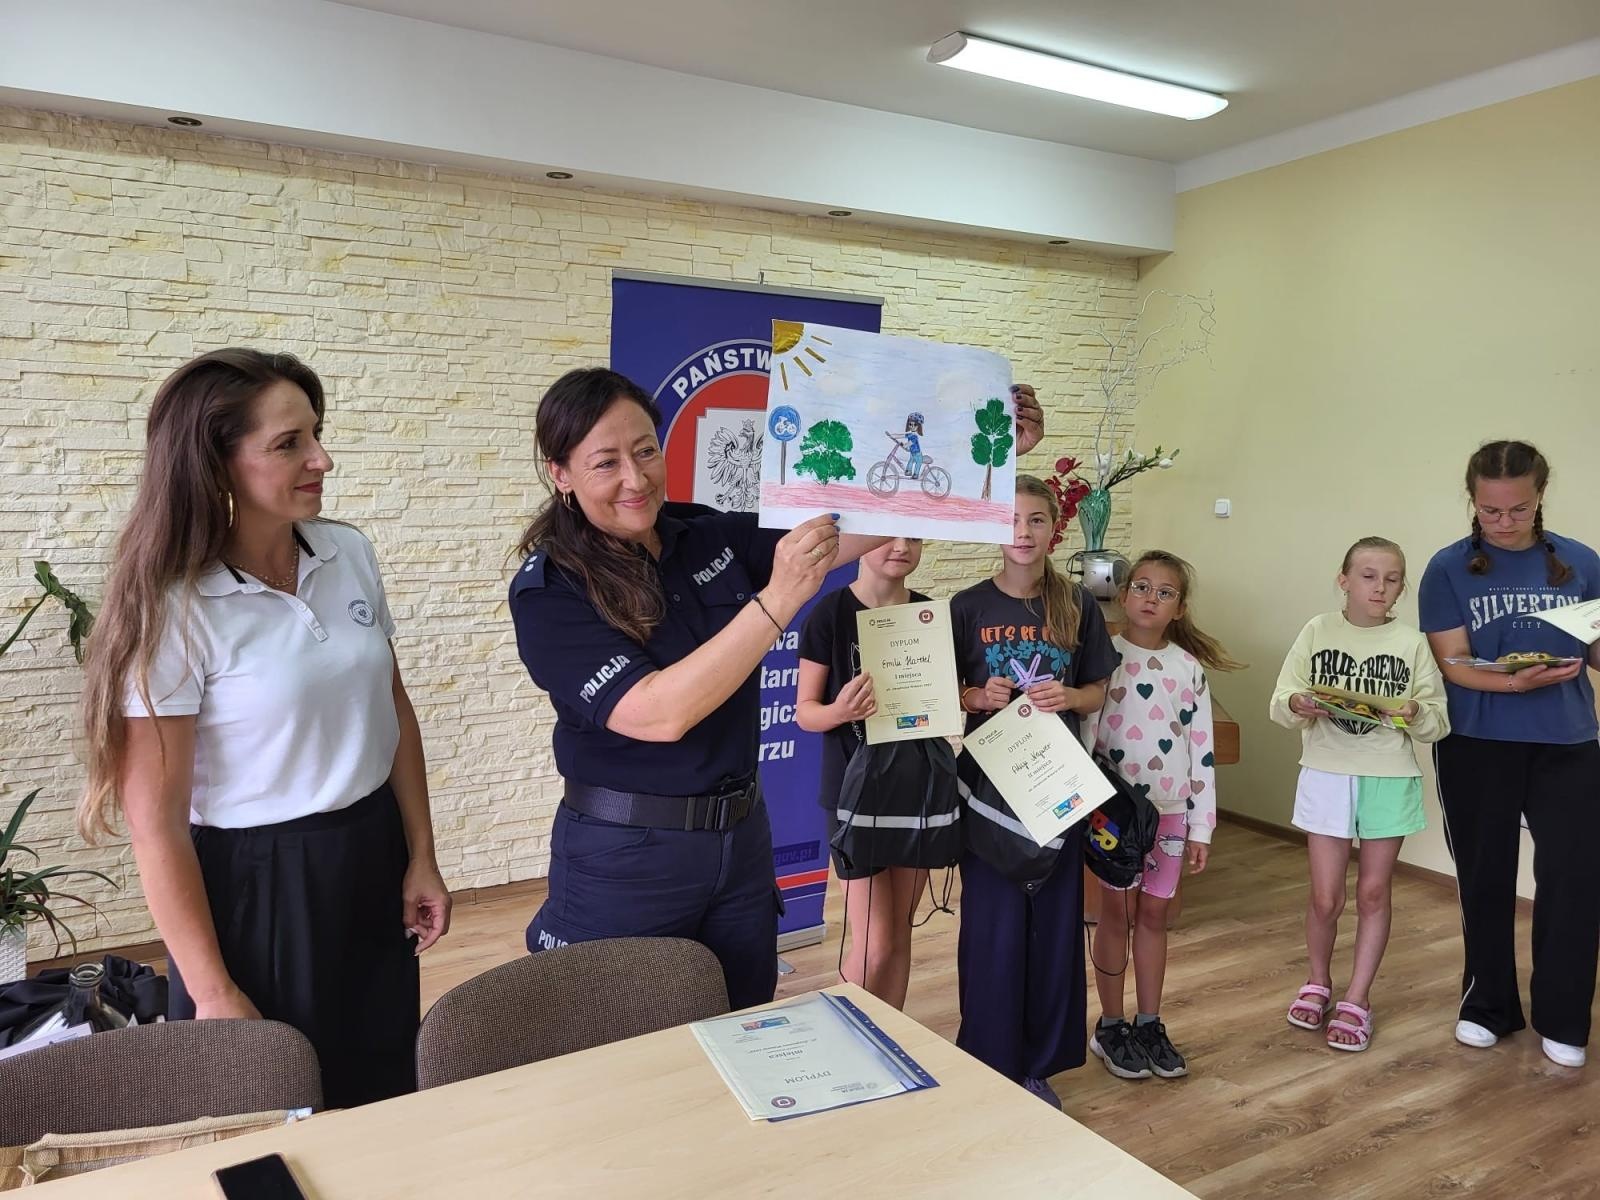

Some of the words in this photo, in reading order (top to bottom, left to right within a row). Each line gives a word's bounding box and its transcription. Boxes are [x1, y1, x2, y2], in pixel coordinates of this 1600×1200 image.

[692, 546, 734, 585] POLICJA
[1020, 625, 1037, 641] BE
[1512, 621, 1542, 629] CITY
[890, 638, 919, 648] DYPLOM
[1310, 649, 1358, 677] TRUE
[1359, 654, 1411, 684] FRIENDS
[579, 655, 631, 704] POLICJA
[758, 740, 795, 762] rzu
[1007, 732, 1032, 753] DYPLOM
[785, 1070, 832, 1084] DYPLOM
